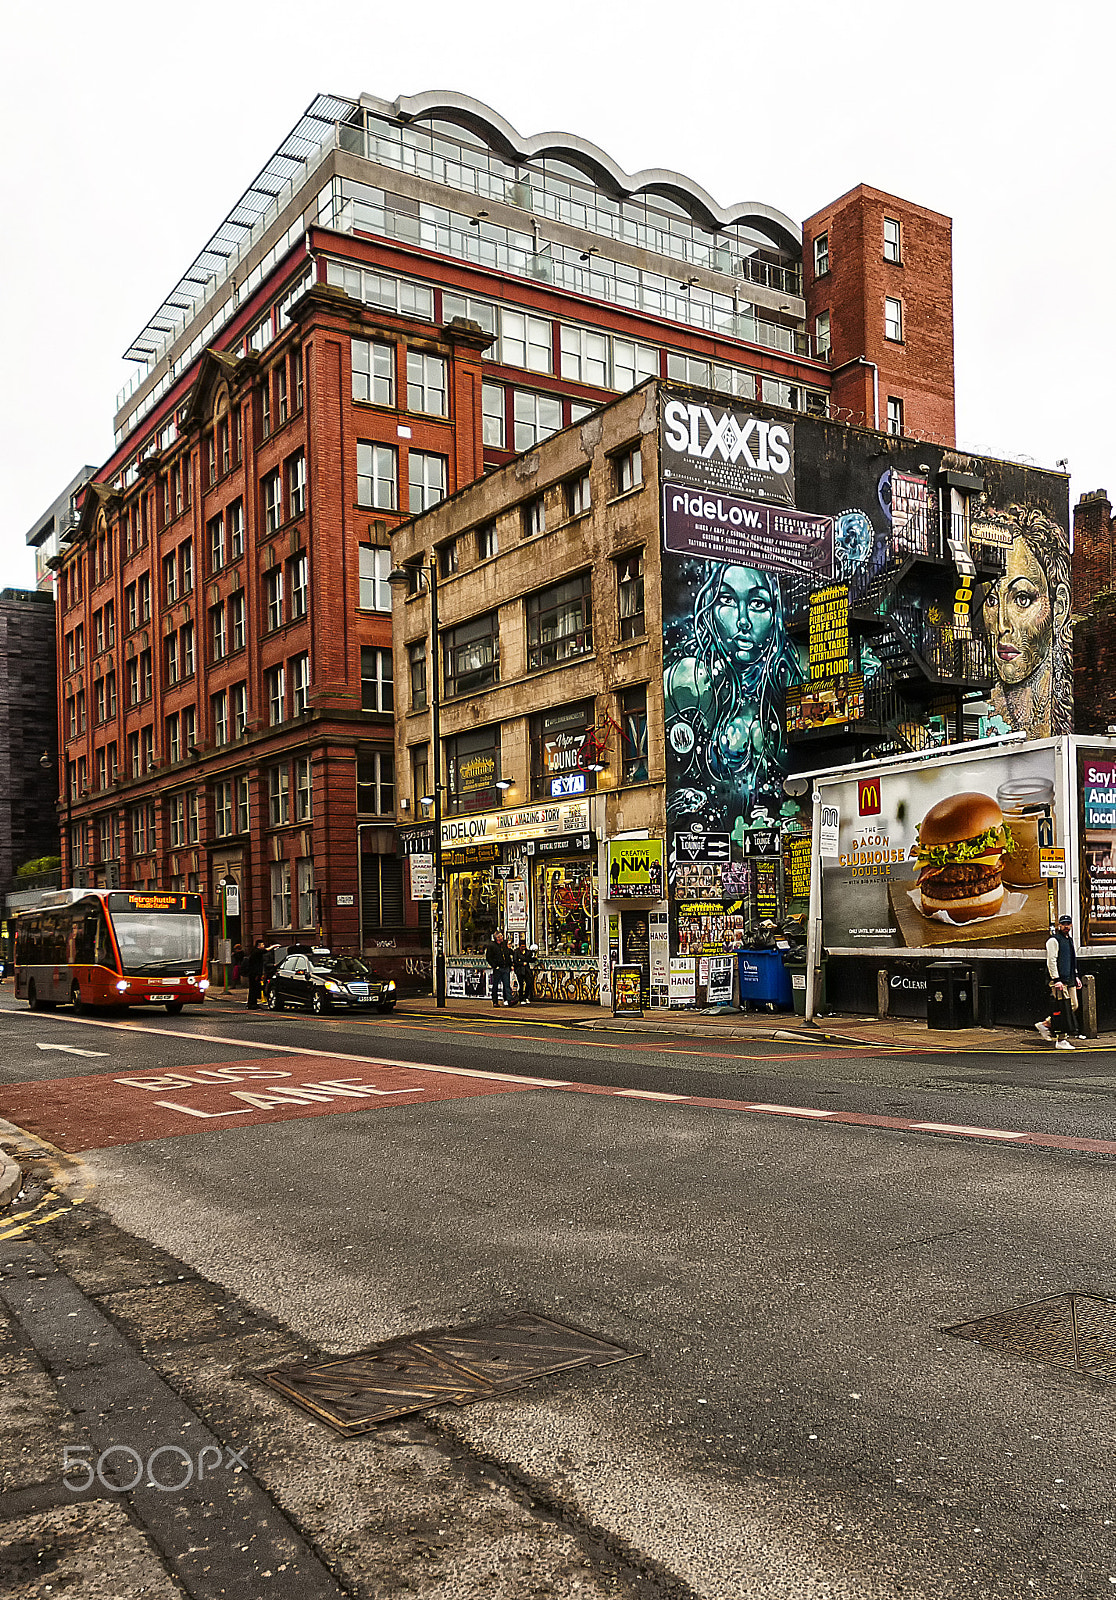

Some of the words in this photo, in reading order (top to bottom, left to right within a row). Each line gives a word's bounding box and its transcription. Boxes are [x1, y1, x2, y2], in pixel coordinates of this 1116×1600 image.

[664, 400, 791, 474] SIXXIS
[774, 515, 809, 529] CREATIVE
[774, 522, 794, 534] STEP
[797, 527, 826, 540] INSIDE
[809, 604, 825, 617] 24HR
[825, 598, 849, 613] TATTOO
[809, 610, 838, 626] PIERCINGS
[809, 621, 831, 635] CAFE
[831, 616, 849, 629] INK
[809, 633, 824, 645] CHILL
[823, 630, 835, 642] OUT
[834, 626, 849, 640] AREA
[809, 643, 828, 654] POOL
[828, 637, 849, 650] TABLE
[809, 646, 849, 663] ENTERTAINMENT
[809, 664, 825, 680] TOP
[825, 658, 849, 677] FLOOR
[548, 748, 584, 771] LOUNGE
[1088, 767, 1111, 788] Say
[496, 814, 514, 829] TRULY
[514, 810, 541, 826] AMAZING
[541, 808, 560, 822] STORY
[441, 818, 488, 842] RIDELOW
[864, 826, 877, 834] THE
[681, 841, 705, 851] LOUNGE
[754, 836, 771, 846] LOUNGE
[852, 835, 890, 851] BACON
[620, 849, 650, 857] CREATIVE
[838, 848, 905, 868] CLUBHOUSE
[621, 856, 650, 872] NW
[791, 868, 807, 877] CAFE
[851, 864, 892, 878] DOUBLE
[792, 881, 805, 889] POOL
[128, 895, 177, 904] Metroshuttle
[180, 896, 187, 910] 1
[649, 932, 668, 941] HANG
[671, 977, 695, 986] HANG
[112, 1066, 293, 1092] BUS
[152, 1077, 426, 1119] LANE
